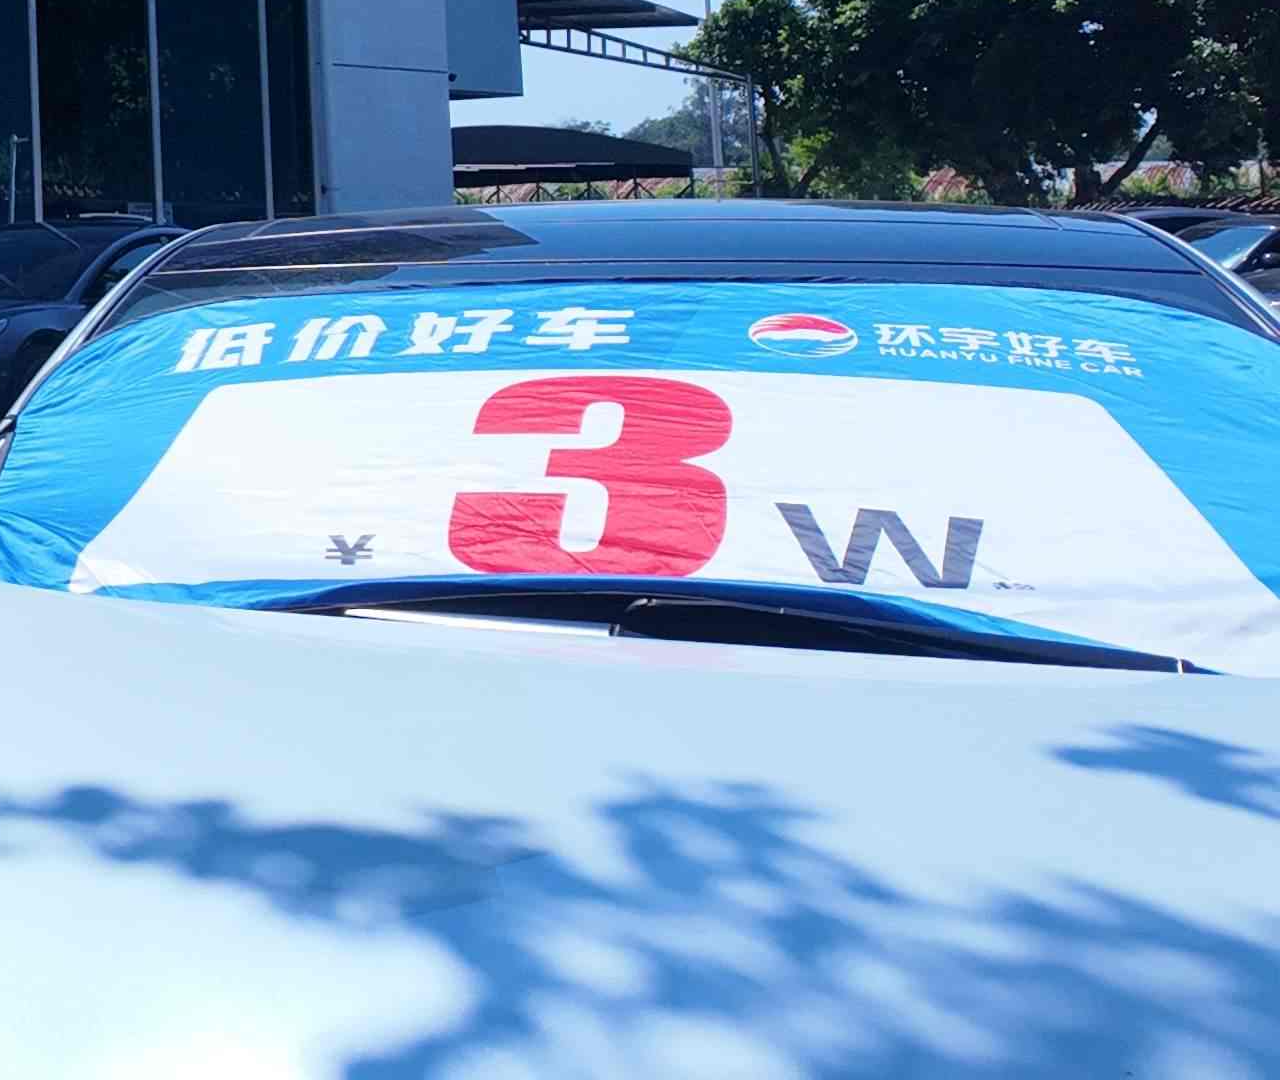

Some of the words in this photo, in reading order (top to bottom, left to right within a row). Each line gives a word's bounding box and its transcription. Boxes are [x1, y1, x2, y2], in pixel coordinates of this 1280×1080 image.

[174, 306, 636, 373] 低价好车
[872, 322, 1137, 364] 环宇好车
[879, 346, 998, 364] HUANYU
[1007, 354, 1076, 371] FINE
[1080, 362, 1145, 378] CAR
[324, 533, 377, 566] ¥
[447, 375, 733, 578] 3
[775, 501, 985, 589] W
